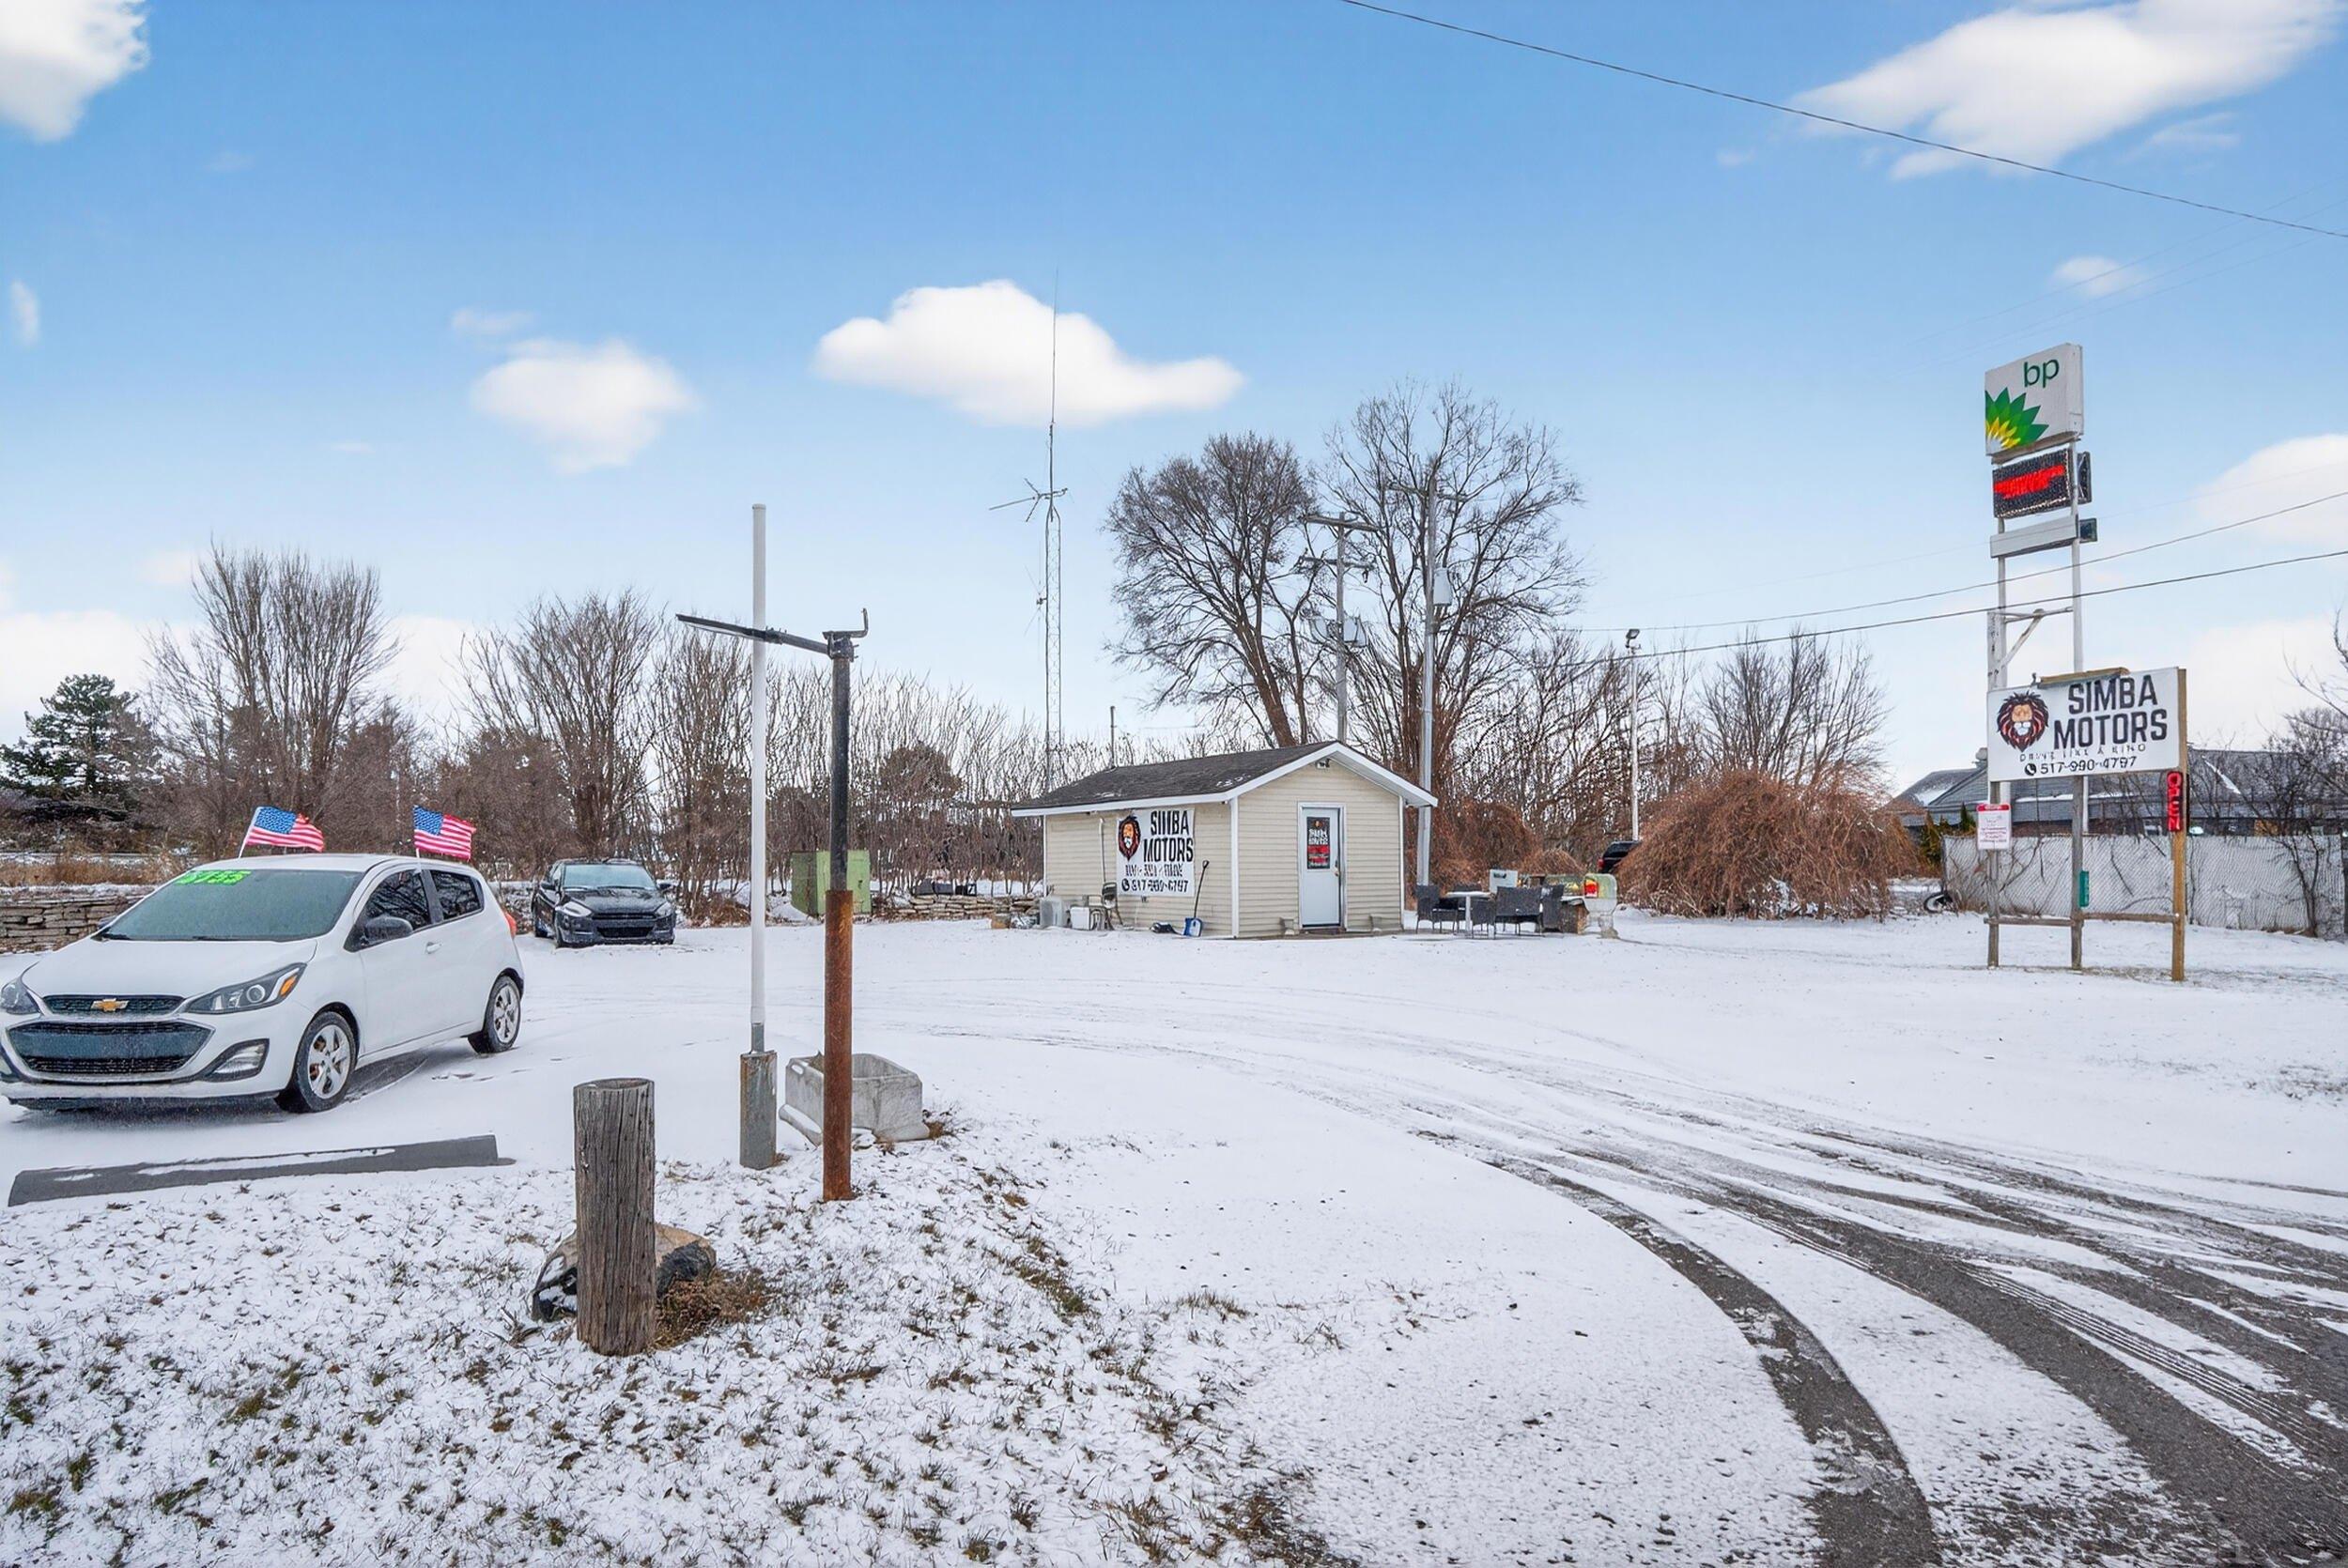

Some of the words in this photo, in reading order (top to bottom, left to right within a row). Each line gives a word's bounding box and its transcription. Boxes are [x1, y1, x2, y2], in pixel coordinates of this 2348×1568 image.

[2023, 359, 2060, 389] bp
[2067, 674, 2158, 715] SIMBA
[2053, 708, 2168, 750] MOTORS
[2167, 771, 2183, 831] OPEN
[1151, 810, 1190, 836] SIMBA
[1143, 837, 1194, 863] MOTORS
